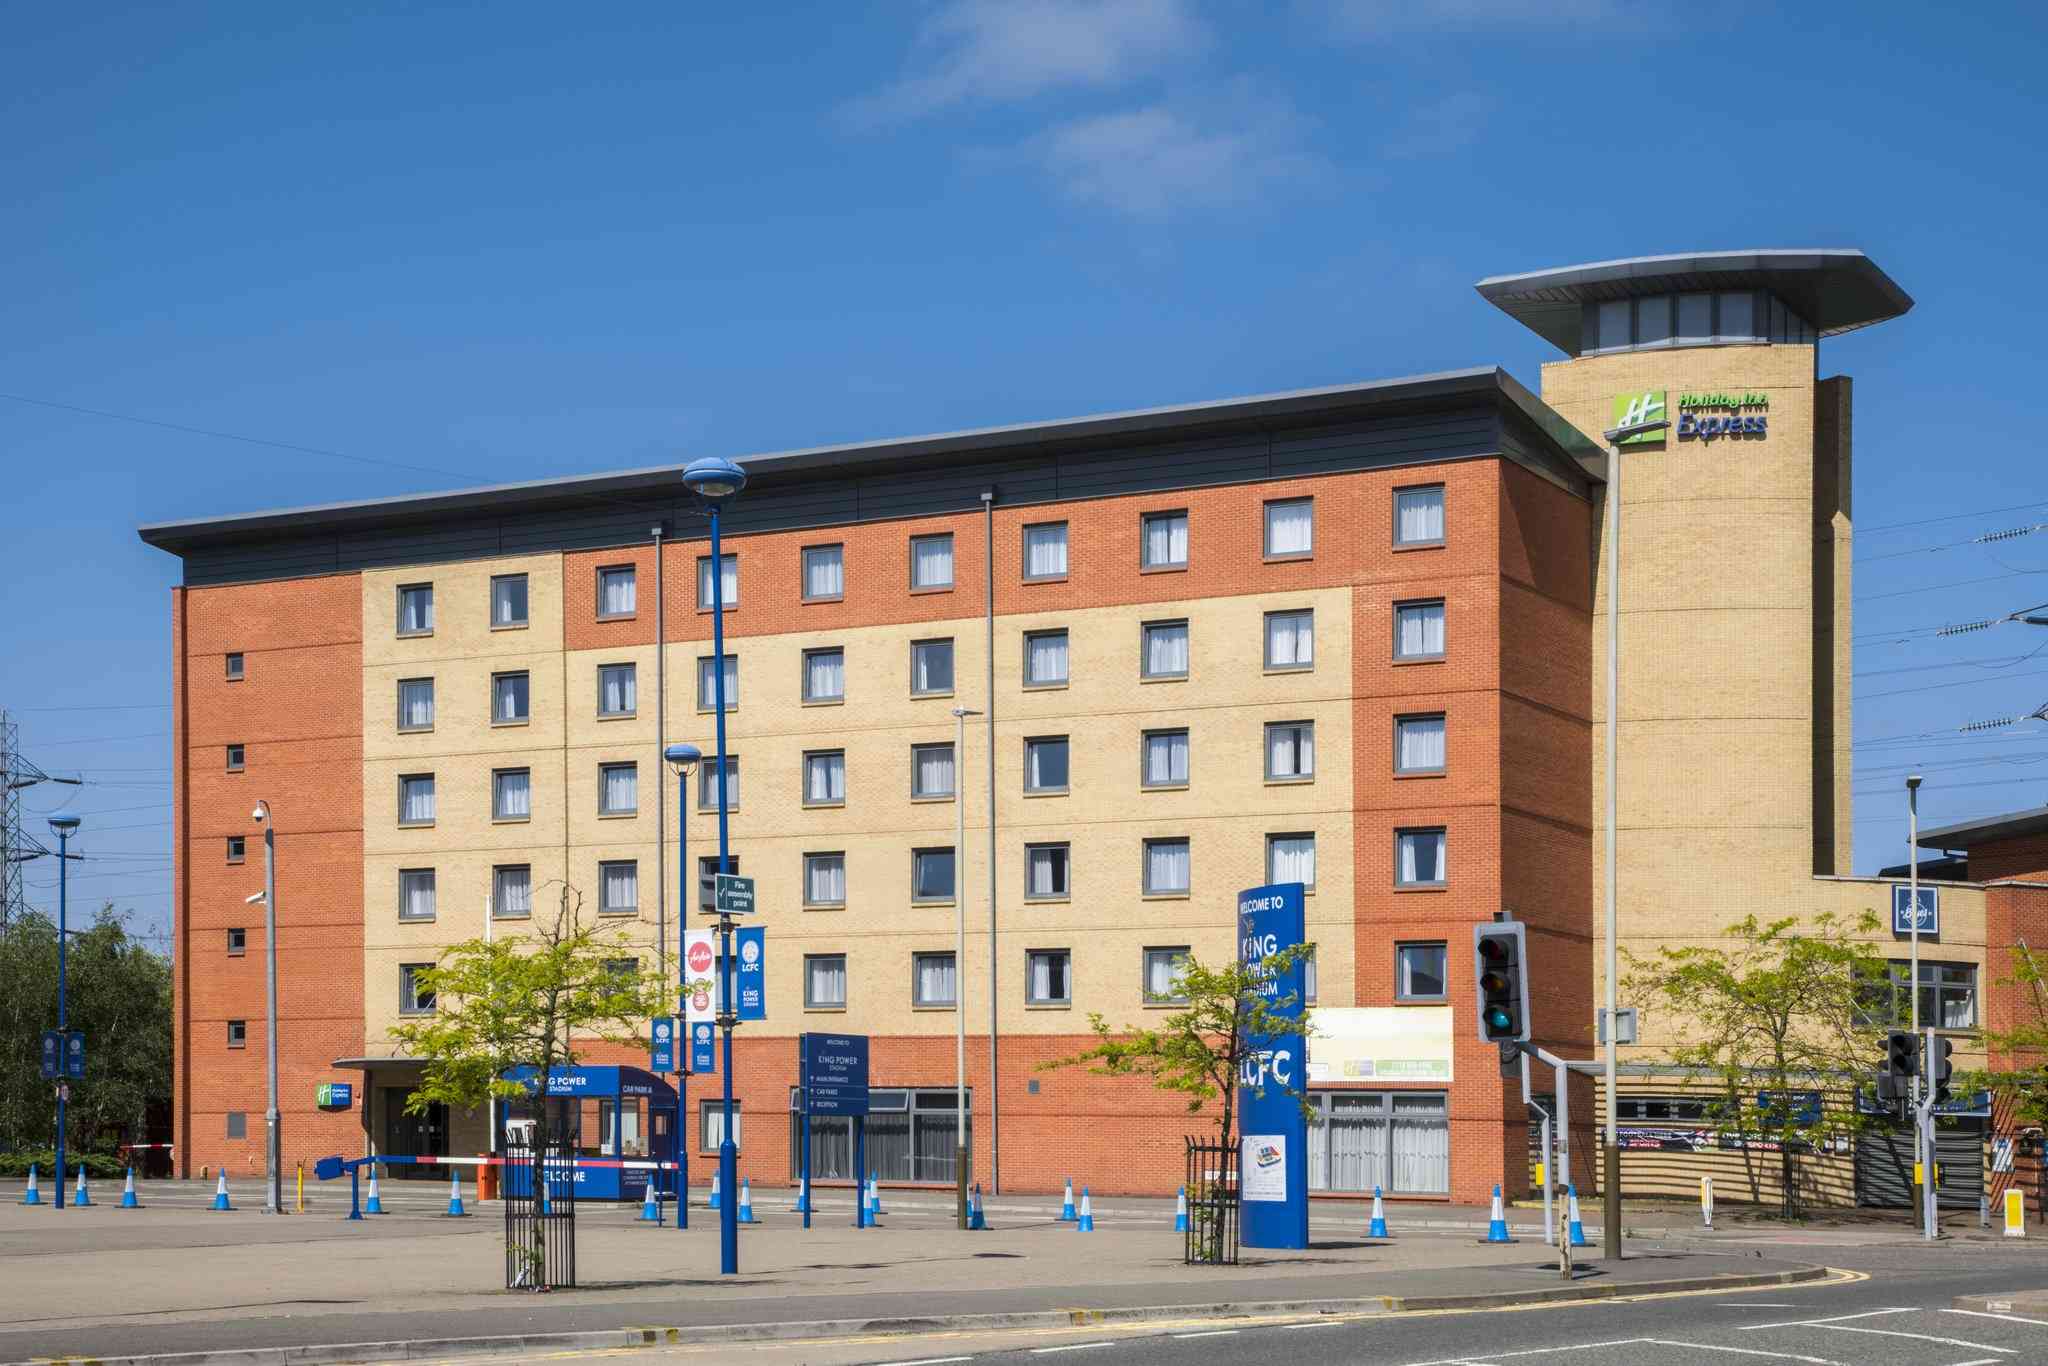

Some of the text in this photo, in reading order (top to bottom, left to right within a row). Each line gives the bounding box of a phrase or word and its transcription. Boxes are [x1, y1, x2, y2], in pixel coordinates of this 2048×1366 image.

[1679, 391, 1740, 408] Holiday
[1677, 412, 1768, 438] Express
[734, 880, 746, 889] Fire
[1240, 896, 1284, 914] WELCOME TO
[1242, 934, 1278, 960] KING
[742, 964, 759, 972] LCFC
[818, 1056, 858, 1064] KING POWER
[1240, 1050, 1291, 1086] LCFC
[557, 1077, 586, 1086] POWER
[544, 1171, 585, 1182] ELCOME
